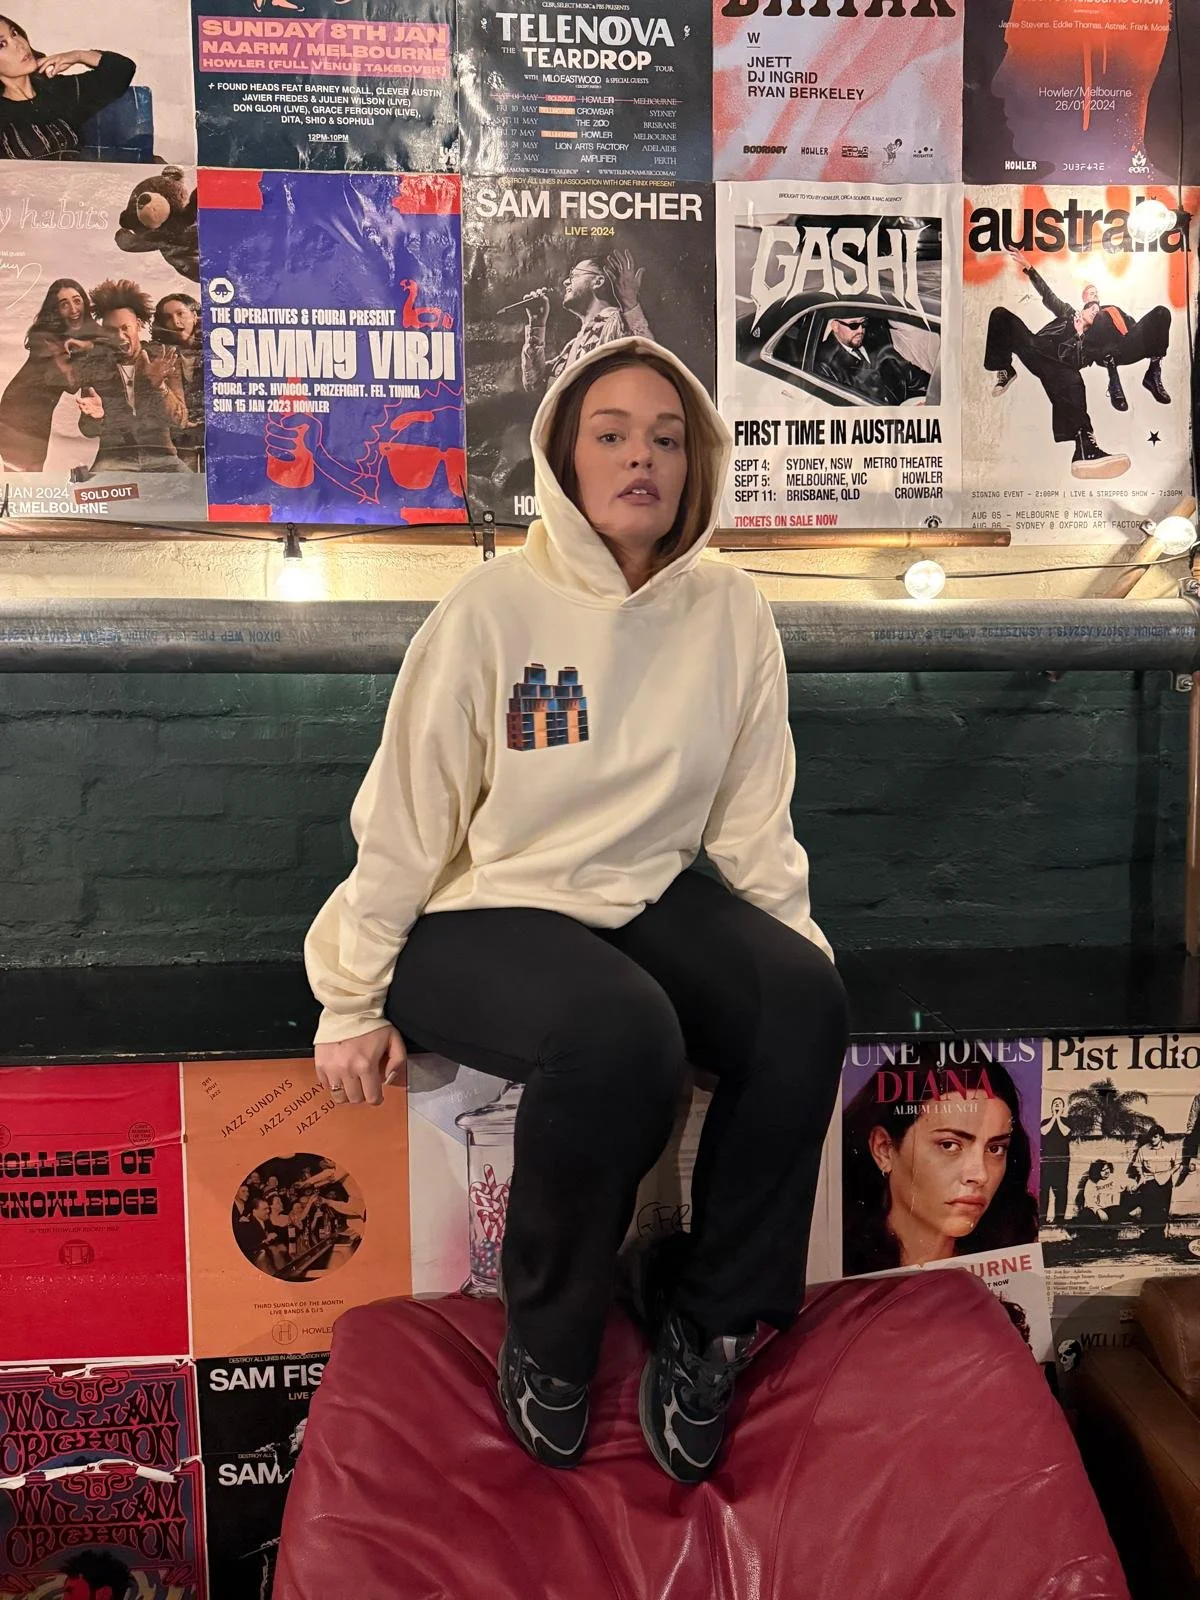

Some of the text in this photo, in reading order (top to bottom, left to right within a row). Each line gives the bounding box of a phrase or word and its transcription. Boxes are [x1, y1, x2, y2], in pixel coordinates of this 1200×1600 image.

[202, 20, 446, 43] SUNDAY 8TH JAN
[495, 12, 675, 47] TELENOVA
[747, 32, 760, 44] W
[203, 41, 446, 61] NAARM MELBOURNE
[522, 47, 652, 70] TEARDROP
[747, 56, 792, 68] JNETT
[203, 58, 447, 75] HOWLER (FULL VENUE TAKEOVER)
[748, 71, 818, 84] DJ INGRID
[217, 83, 248, 91] FOUND
[250, 84, 280, 92] HEADS
[305, 86, 340, 94] BARNEY
[376, 87, 409, 96] CLEVER
[748, 86, 864, 100] RYAN BERKELEY
[1039, 86, 1132, 99] Howler/Melbourne
[242, 94, 411, 107] JAVIER FREDES JULIEN WILSON (LIVE)
[1055, 99, 1116, 111] 26/01/2024
[233, 104, 252, 112] DON
[255, 105, 281, 113] GLORI
[313, 106, 343, 115] GRACE
[345, 107, 392, 116] FERGUSON
[522, 105, 538, 113] MAY
[576, 108, 614, 116] CROWBAR
[281, 115, 375, 126] DITA, SHIO SOPHULI
[523, 117, 539, 125] MAY
[643, 121, 677, 129] BRISBANE
[308, 133, 349, 142] 12PM-10PM
[633, 132, 677, 140] MELBOURNE
[574, 143, 594, 151] ARTS
[801, 146, 829, 156] HOWLER
[524, 153, 677, 165] MAY AMPLIFIER PERTH
[1005, 160, 1037, 170] HOWLER
[476, 189, 702, 222] SAM FISCHER
[21, 195, 109, 231] habits
[565, 226, 615, 236] LIVE 2024
[751, 216, 931, 333] GASHI
[210, 307, 396, 326] THE OPERATIVES FOURA PRESENT
[368, 330, 456, 381] VIRJI
[213, 399, 330, 413] SUN 15 JAN 2023 HOWLER
[735, 418, 942, 446] FIRST TIME IN AUSTRALIA
[735, 456, 943, 472] SEPT 4: SYDNEY, NSW METRO THEATRE
[735, 471, 943, 487] SEPT 5: MELBOURNE, VIC HOWLER
[37, 488, 70, 499] 2024
[80, 490, 109, 502] SOLD
[111, 487, 133, 499] OUT
[735, 487, 943, 502] SEPT 11: BRISBANE, QLD CROWBAR
[21, 502, 109, 515] MELBOURNE
[972, 512, 987, 520] AUG
[1016, 511, 1059, 520] MELBOURNE
[1073, 510, 1103, 519] HOWLER
[735, 514, 838, 528] TICKETS ON SALE NOW
[1016, 520, 1107, 530] SYDNEY OXFORD ART
[936, 1037, 1036, 1068] JONES
[1047, 1036, 1118, 1071] Pist
[876, 1067, 995, 1104] DIANA
[221, 1080, 294, 1138] JAZZ SUNDAYS
[894, 1102, 978, 1116] ALBUM LAUNCH
[259, 1112, 286, 1136] JAZZ
[296, 1110, 324, 1135] JAZZ
[0, 1148, 155, 1178] OLLEGE OF
[993, 1279, 1010, 1288] NOW
[273, 1301, 299, 1309] SUNDAY
[321, 1299, 344, 1307] MONTH
[284, 1307, 304, 1315] BANDS
[209, 1365, 276, 1392] SAM
[289, 1391, 310, 1401] LIVE
[218, 1462, 284, 1486] SAM
